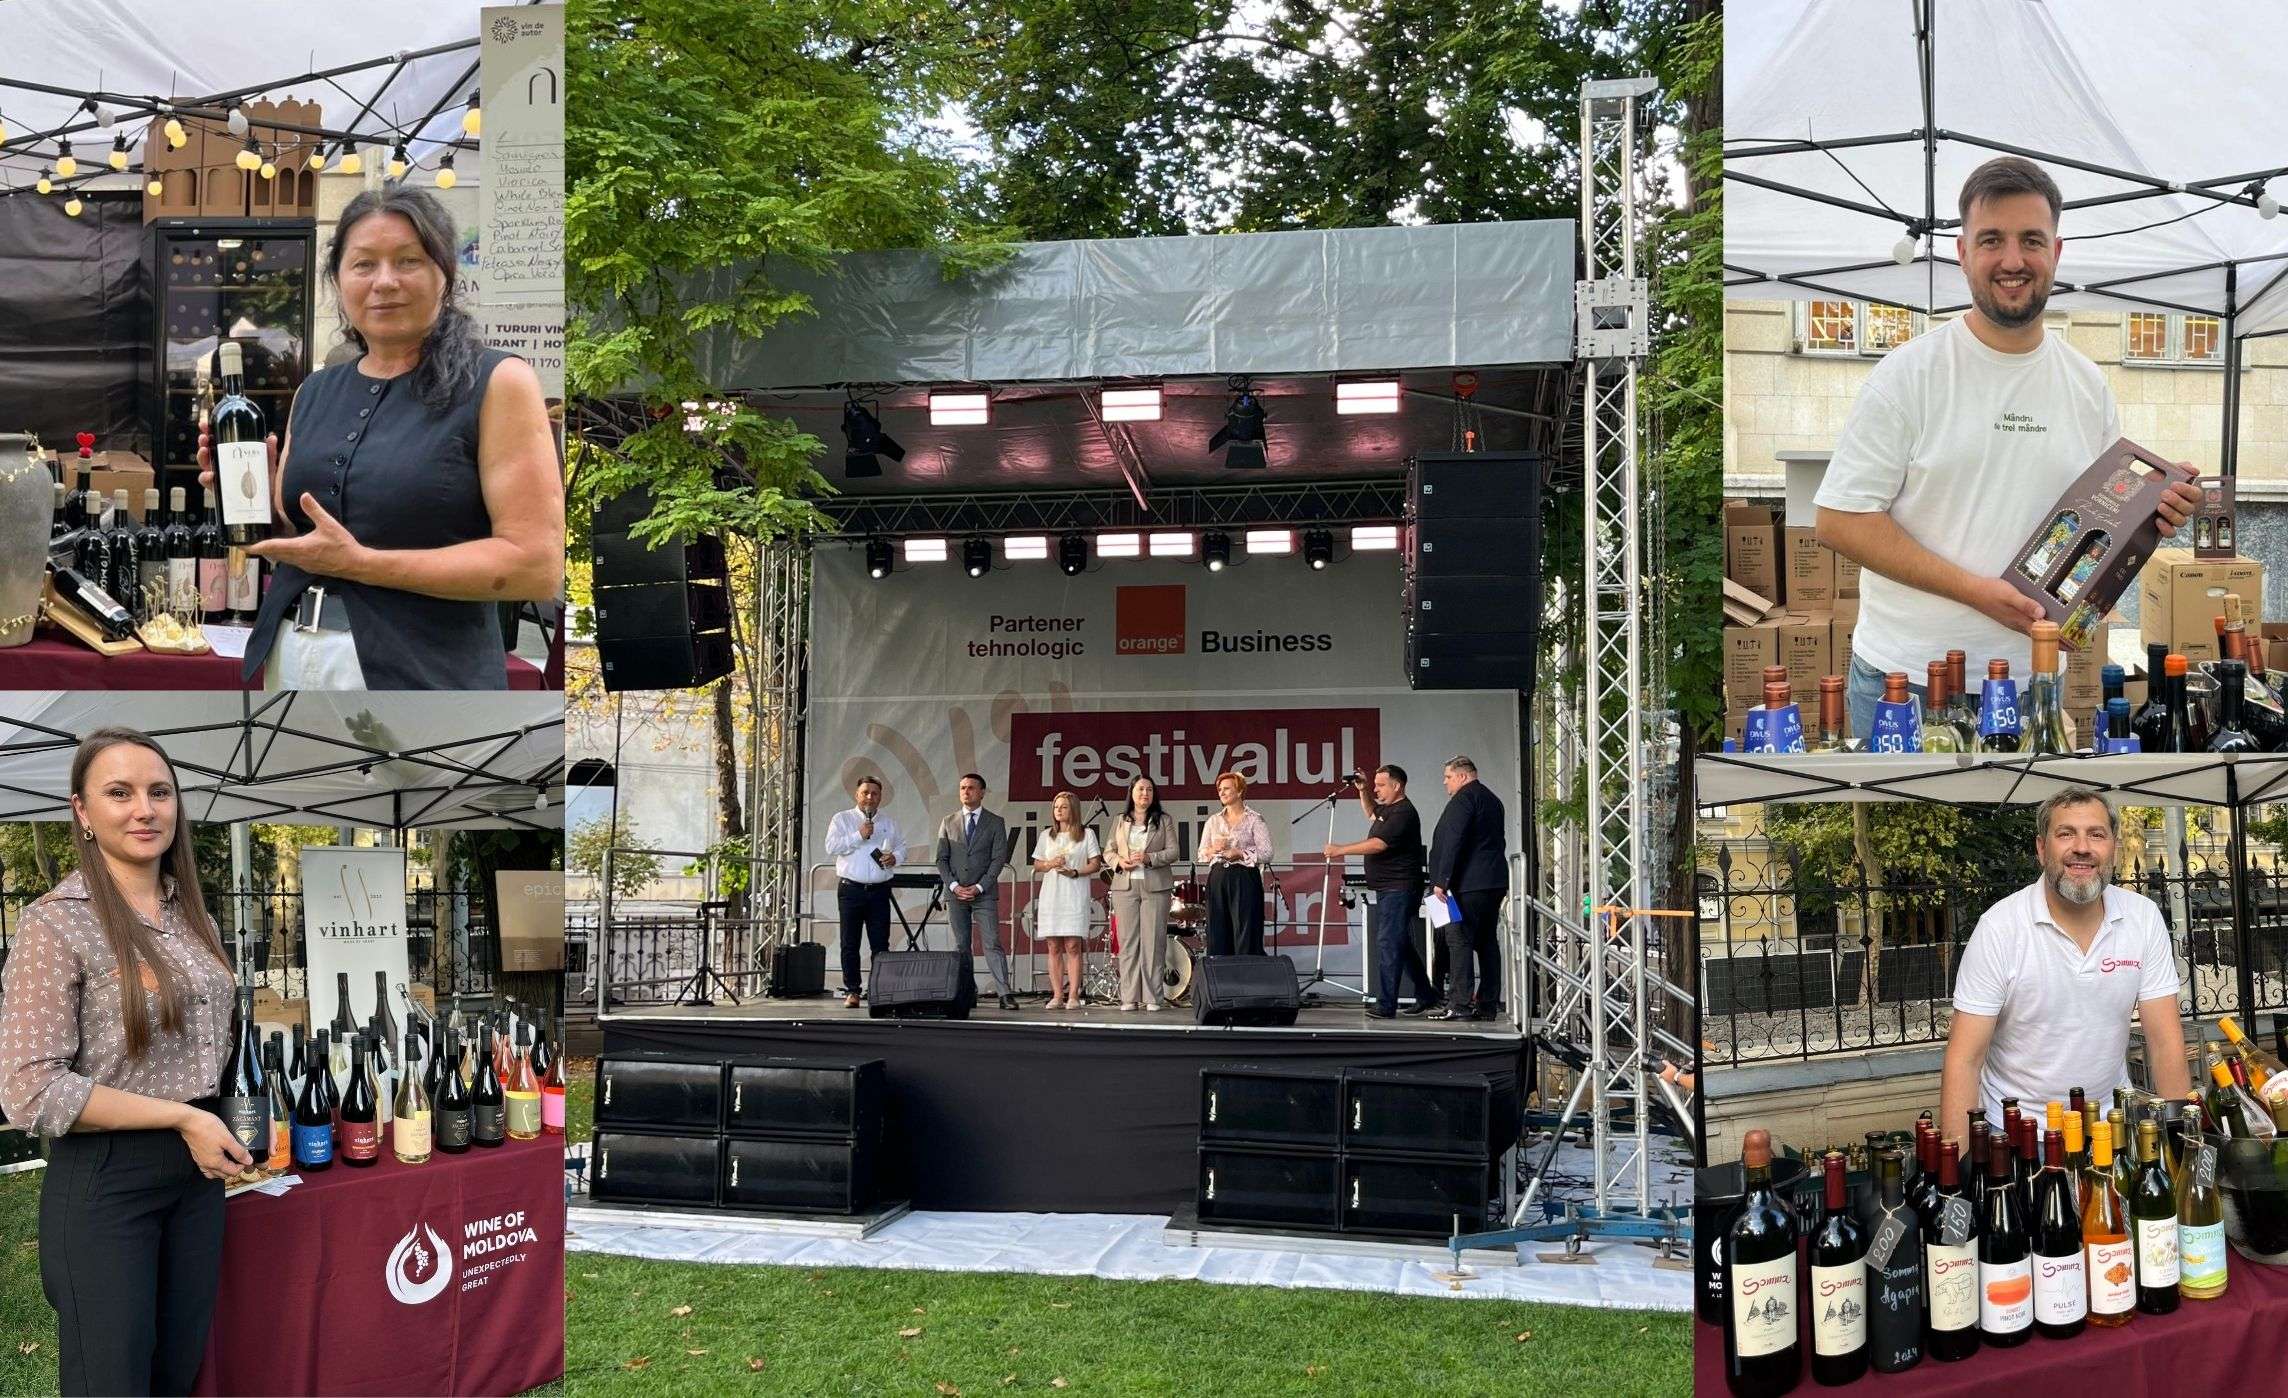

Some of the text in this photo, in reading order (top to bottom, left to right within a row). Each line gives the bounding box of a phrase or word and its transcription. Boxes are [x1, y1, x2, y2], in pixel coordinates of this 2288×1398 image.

[521, 22, 545, 30] vin de
[496, 324, 540, 334] TURURI
[540, 359, 561, 368] 170
[989, 614, 1086, 633] Partener
[967, 638, 1085, 660] tehnologic
[1201, 629, 1333, 653] Business
[1036, 726, 1354, 788] festivalul
[318, 920, 398, 937] vinhart
[2199, 1149, 2214, 1182] 200
[464, 1210, 525, 1239] WINE OF
[1948, 1202, 1967, 1239] 150
[463, 1227, 539, 1260] MOLDOVA
[1873, 1226, 1895, 1262] 200
[462, 1253, 527, 1279] UNEXPECTEDLY
[461, 1276, 489, 1292] GREAT
[2053, 1299, 2076, 1309] PULSE
